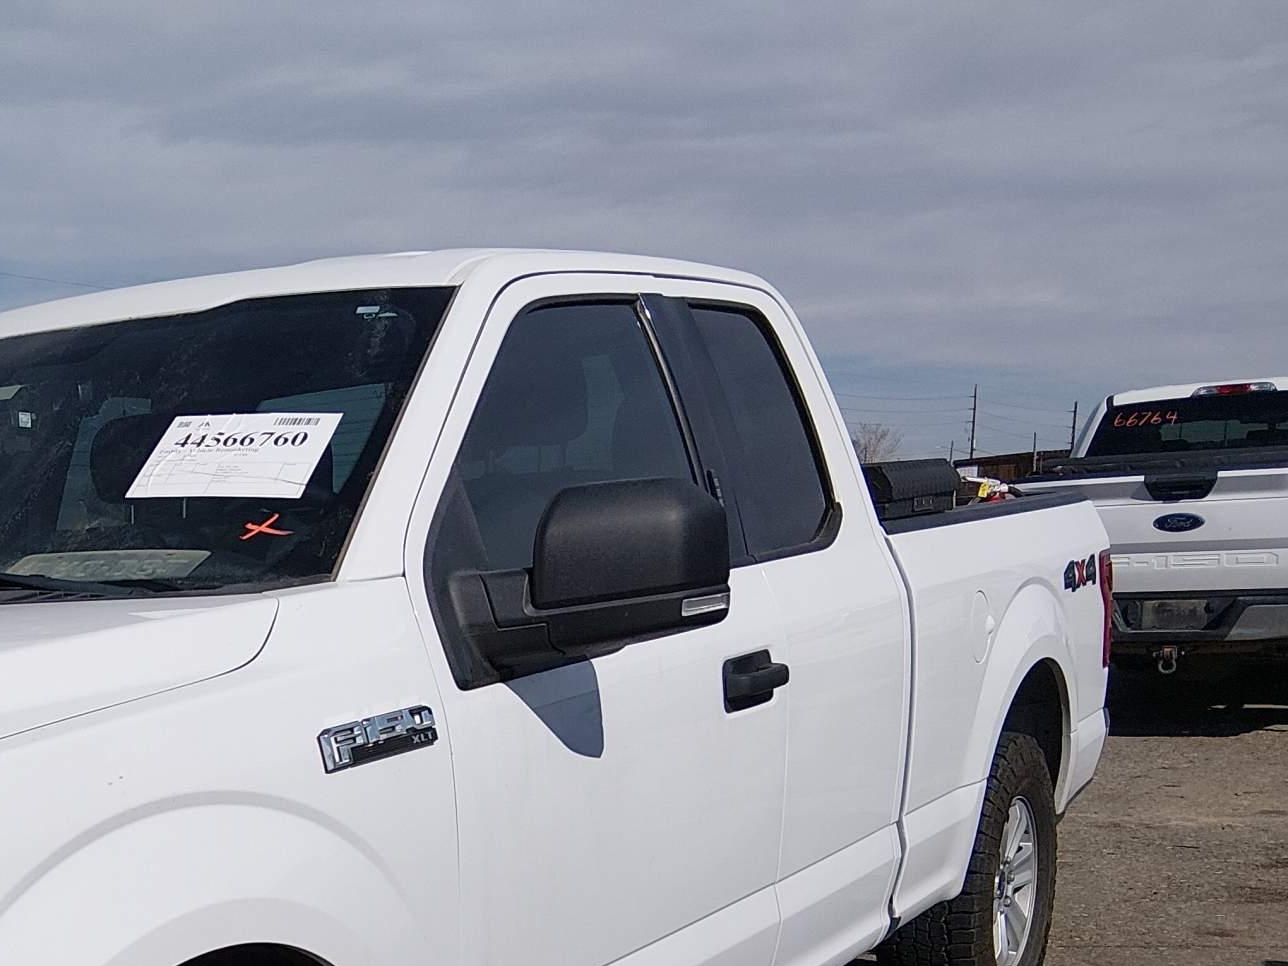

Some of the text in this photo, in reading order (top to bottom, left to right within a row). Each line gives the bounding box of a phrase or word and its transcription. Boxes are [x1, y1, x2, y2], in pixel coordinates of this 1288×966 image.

[1114, 411, 1178, 427] 66764
[174, 431, 309, 448] 44566760
[412, 731, 434, 744] XLT
